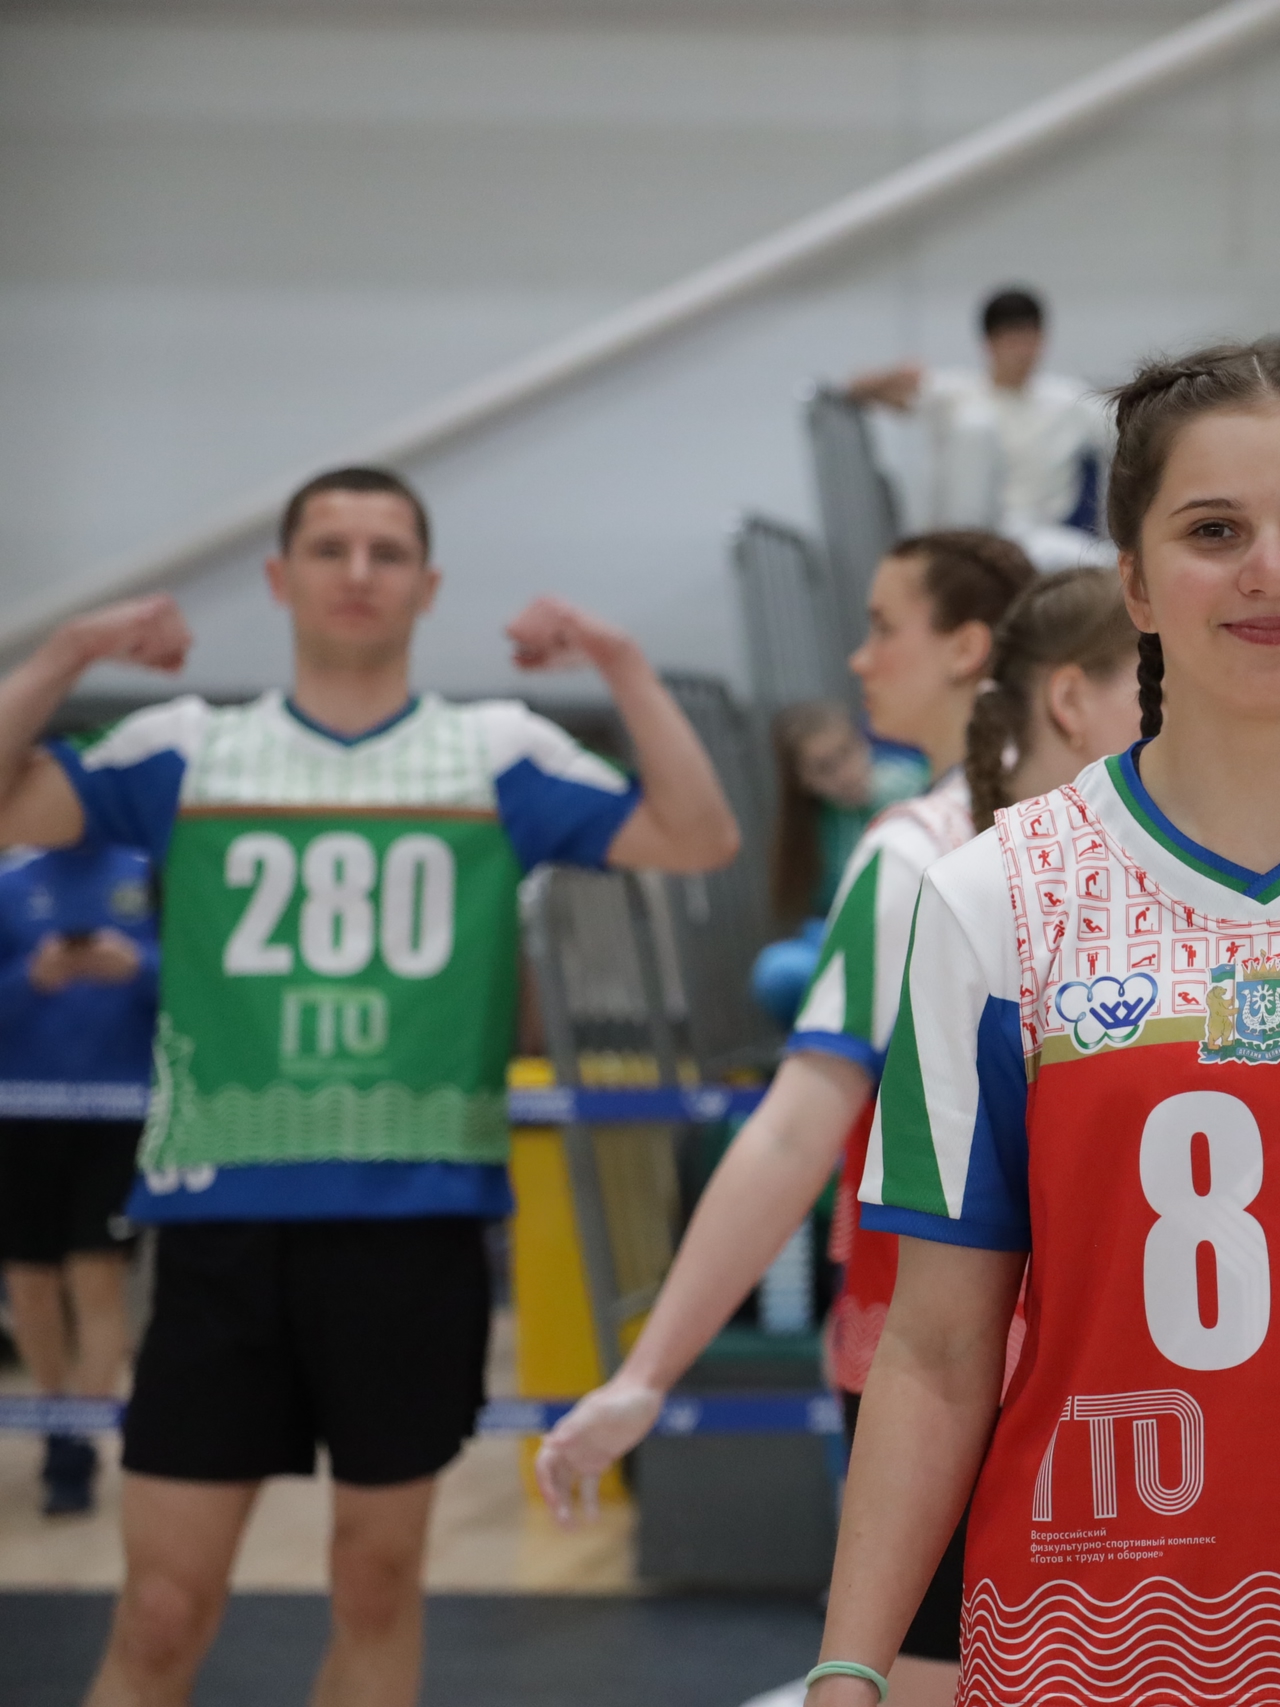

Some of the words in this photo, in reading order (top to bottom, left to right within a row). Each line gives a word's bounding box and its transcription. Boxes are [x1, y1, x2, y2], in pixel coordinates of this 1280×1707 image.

[222, 830, 456, 980] 280
[1030, 1527, 1107, 1541] Всероссийский
[1030, 1536, 1166, 1553] физкультурно-спортивный
[1167, 1536, 1217, 1546] комплекс
[1030, 1553, 1064, 1564] «Готов
[1075, 1552, 1105, 1564] труду
[1107, 1552, 1114, 1560] и
[1117, 1550, 1164, 1560] обороне»
